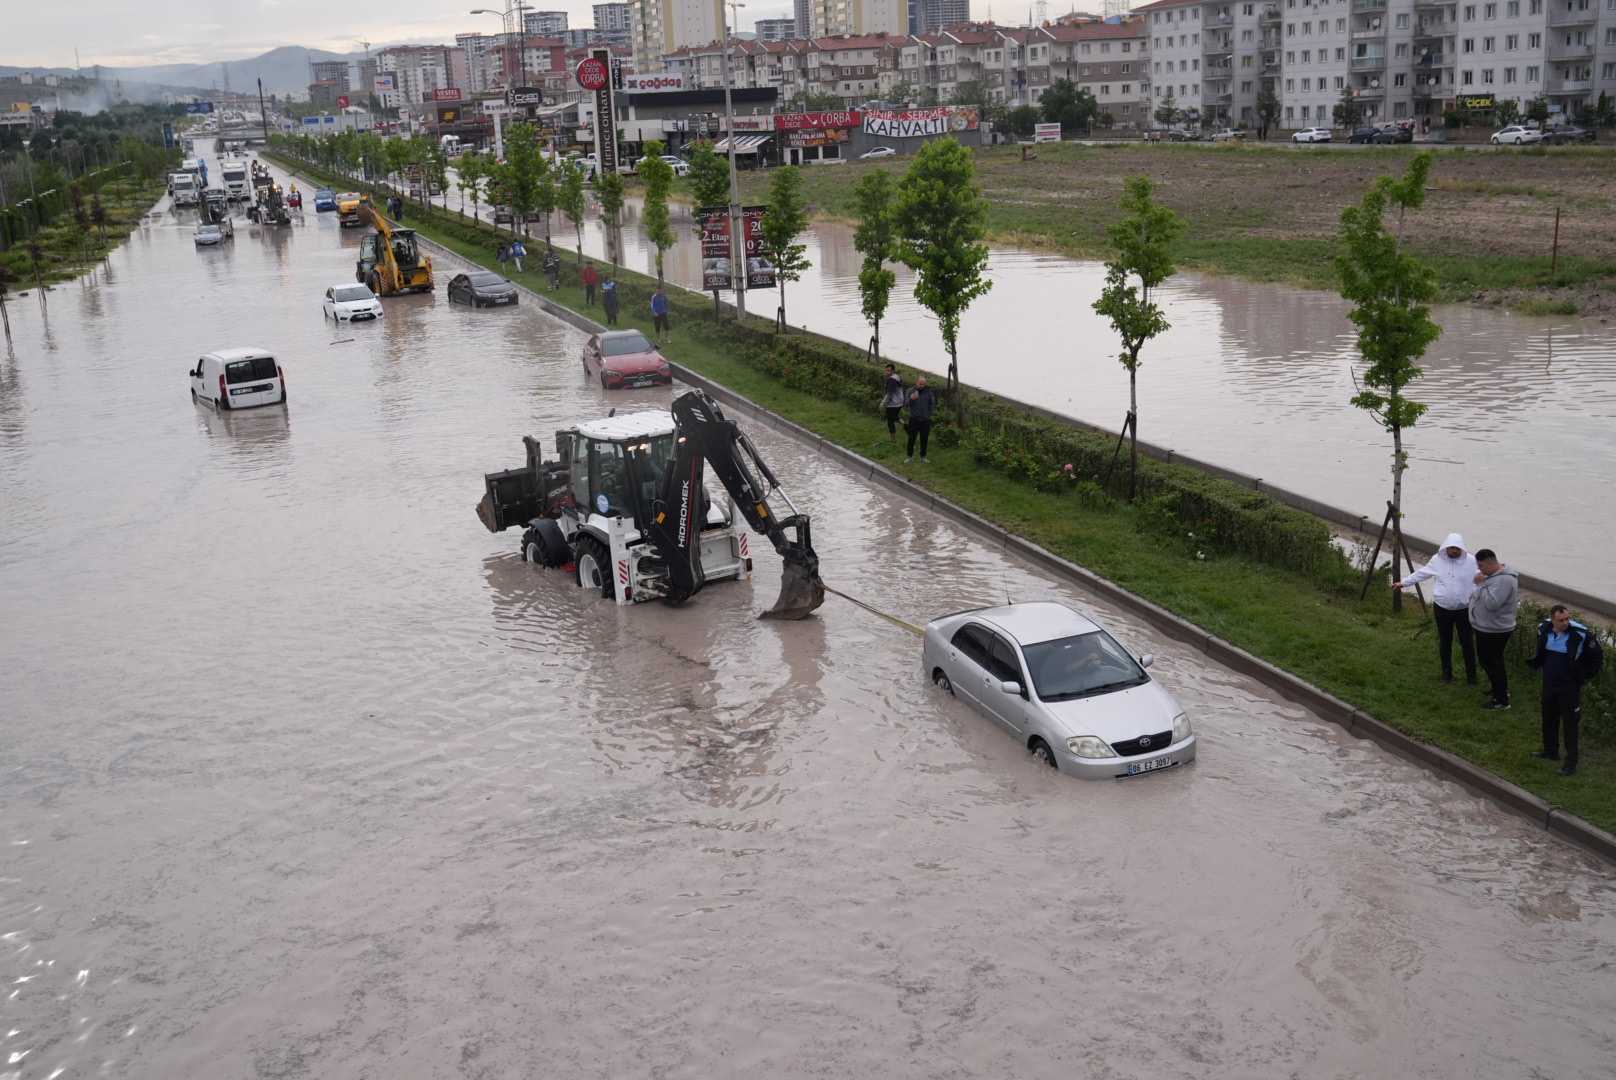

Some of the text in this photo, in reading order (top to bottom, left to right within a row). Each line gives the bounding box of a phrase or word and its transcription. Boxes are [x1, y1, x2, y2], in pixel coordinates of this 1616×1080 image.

[580, 73, 605, 86] ÇORBA
[639, 77, 681, 89] çağdaş
[820, 112, 851, 126] ÇORBA
[865, 118, 944, 136] KAHVALTI
[1144, 761, 1153, 770] EZ
